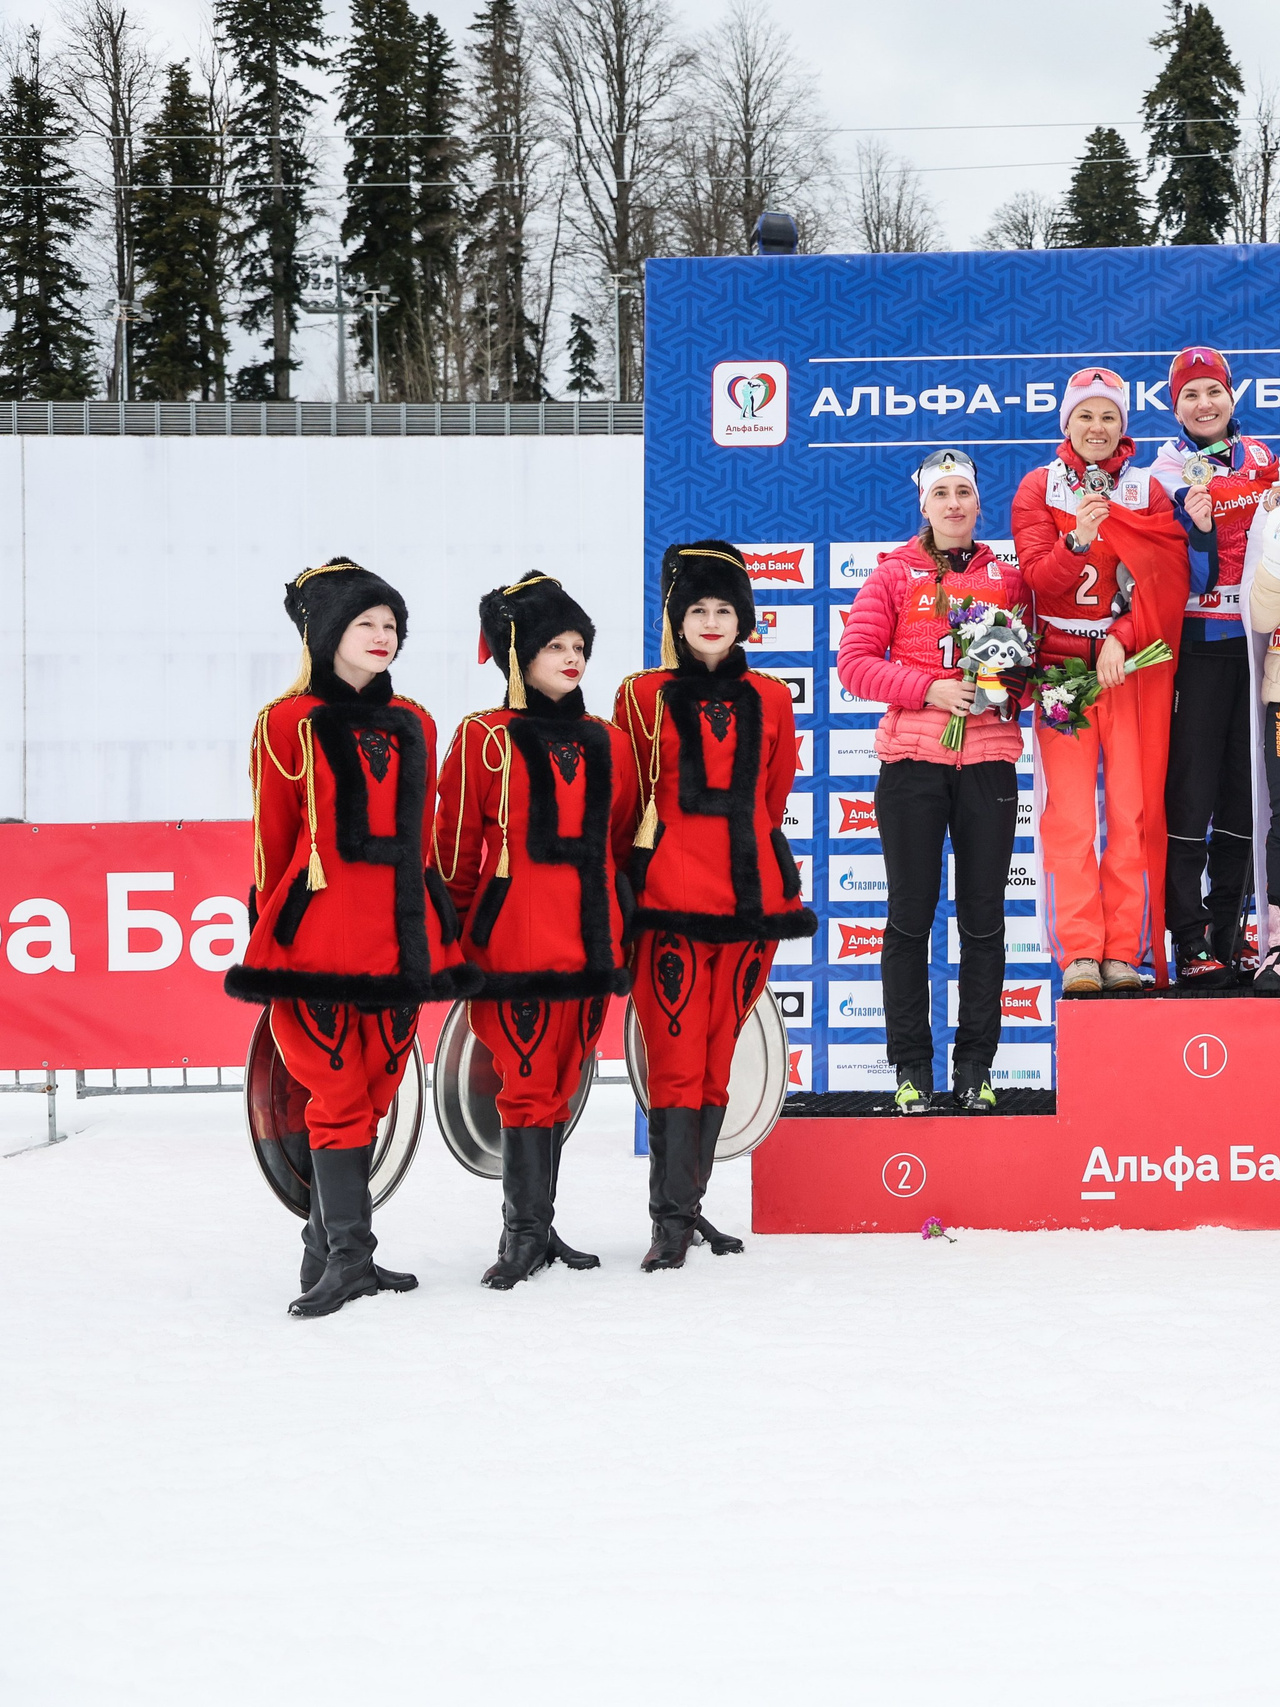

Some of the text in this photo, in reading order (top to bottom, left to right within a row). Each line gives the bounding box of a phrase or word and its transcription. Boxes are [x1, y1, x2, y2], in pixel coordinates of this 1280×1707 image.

[810, 381, 1169, 416] АЛЬФА-БК
[726, 425, 752, 434] Альфа
[1214, 491, 1265, 513] Альфа Ба
[746, 561, 795, 573] ьфа Банк
[1075, 563, 1099, 605] 2
[937, 634, 960, 669] 1
[849, 809, 876, 821] Альф
[1007, 877, 1036, 886] КОЛЬ
[106, 871, 250, 972] Ба
[848, 934, 884, 947] Альфа
[1246, 932, 1258, 942] Ба
[1012, 943, 1040, 952] ПОЛЯНА
[1004, 997, 1032, 1007] Банк
[1197, 1042, 1208, 1070] 1
[1012, 1070, 1040, 1079] ПОЛЯНА
[897, 1160, 912, 1189] 2
[1081, 1145, 1220, 1195] Альфа
